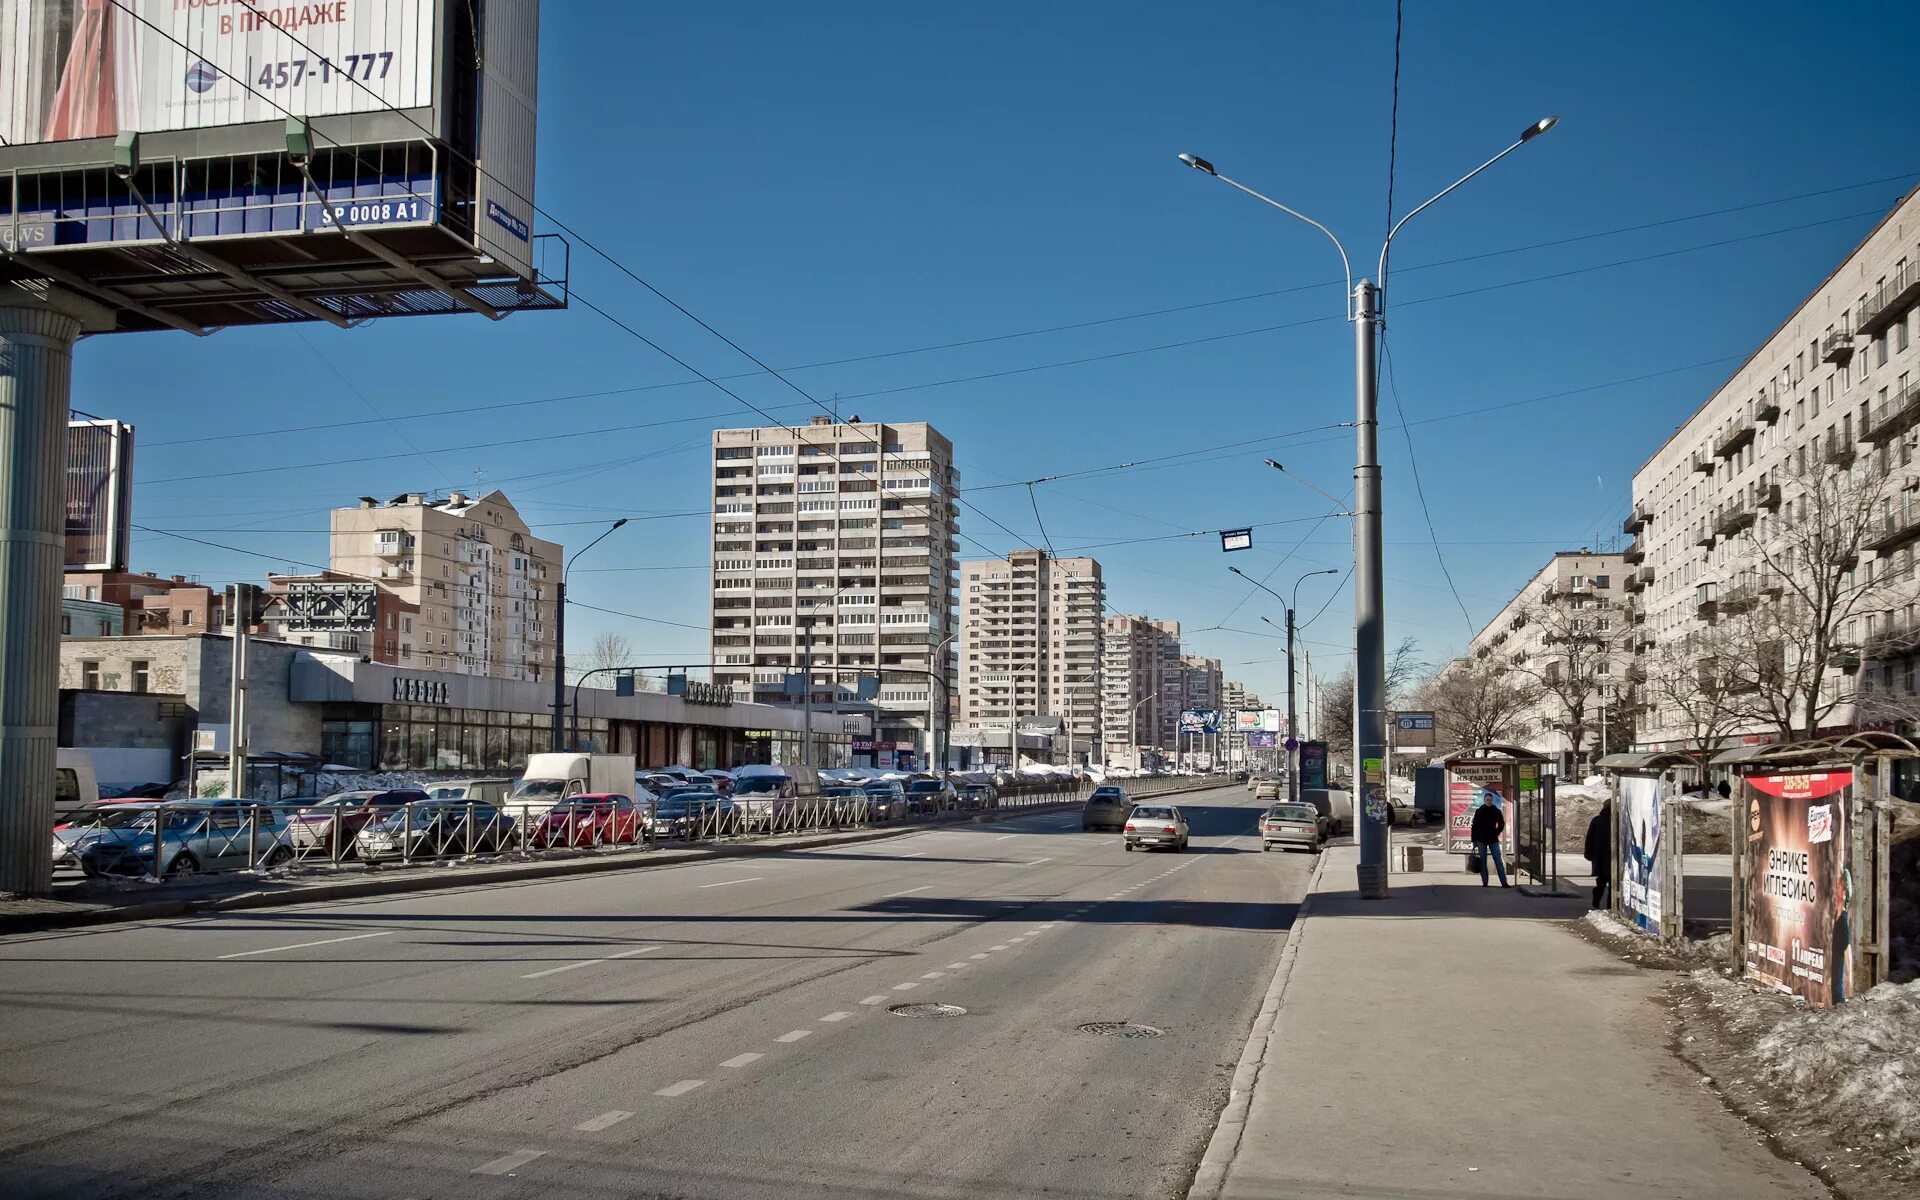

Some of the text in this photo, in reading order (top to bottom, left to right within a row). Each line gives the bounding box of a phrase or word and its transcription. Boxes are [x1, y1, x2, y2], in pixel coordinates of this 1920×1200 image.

[220, 14, 232, 35] В
[239, 2, 347, 33] ПРОДАЖЕ
[258, 51, 394, 90] 457-1-777
[322, 202, 418, 224] SP 0008 A1
[393, 677, 450, 704] МЕБЕЛЬ
[1454, 765, 1480, 775] Цены
[1768, 849, 1808, 875] ЭНРИКЕ
[1762, 872, 1816, 904] ИГЛЕСИАС
[1791, 937, 1800, 962] 11
